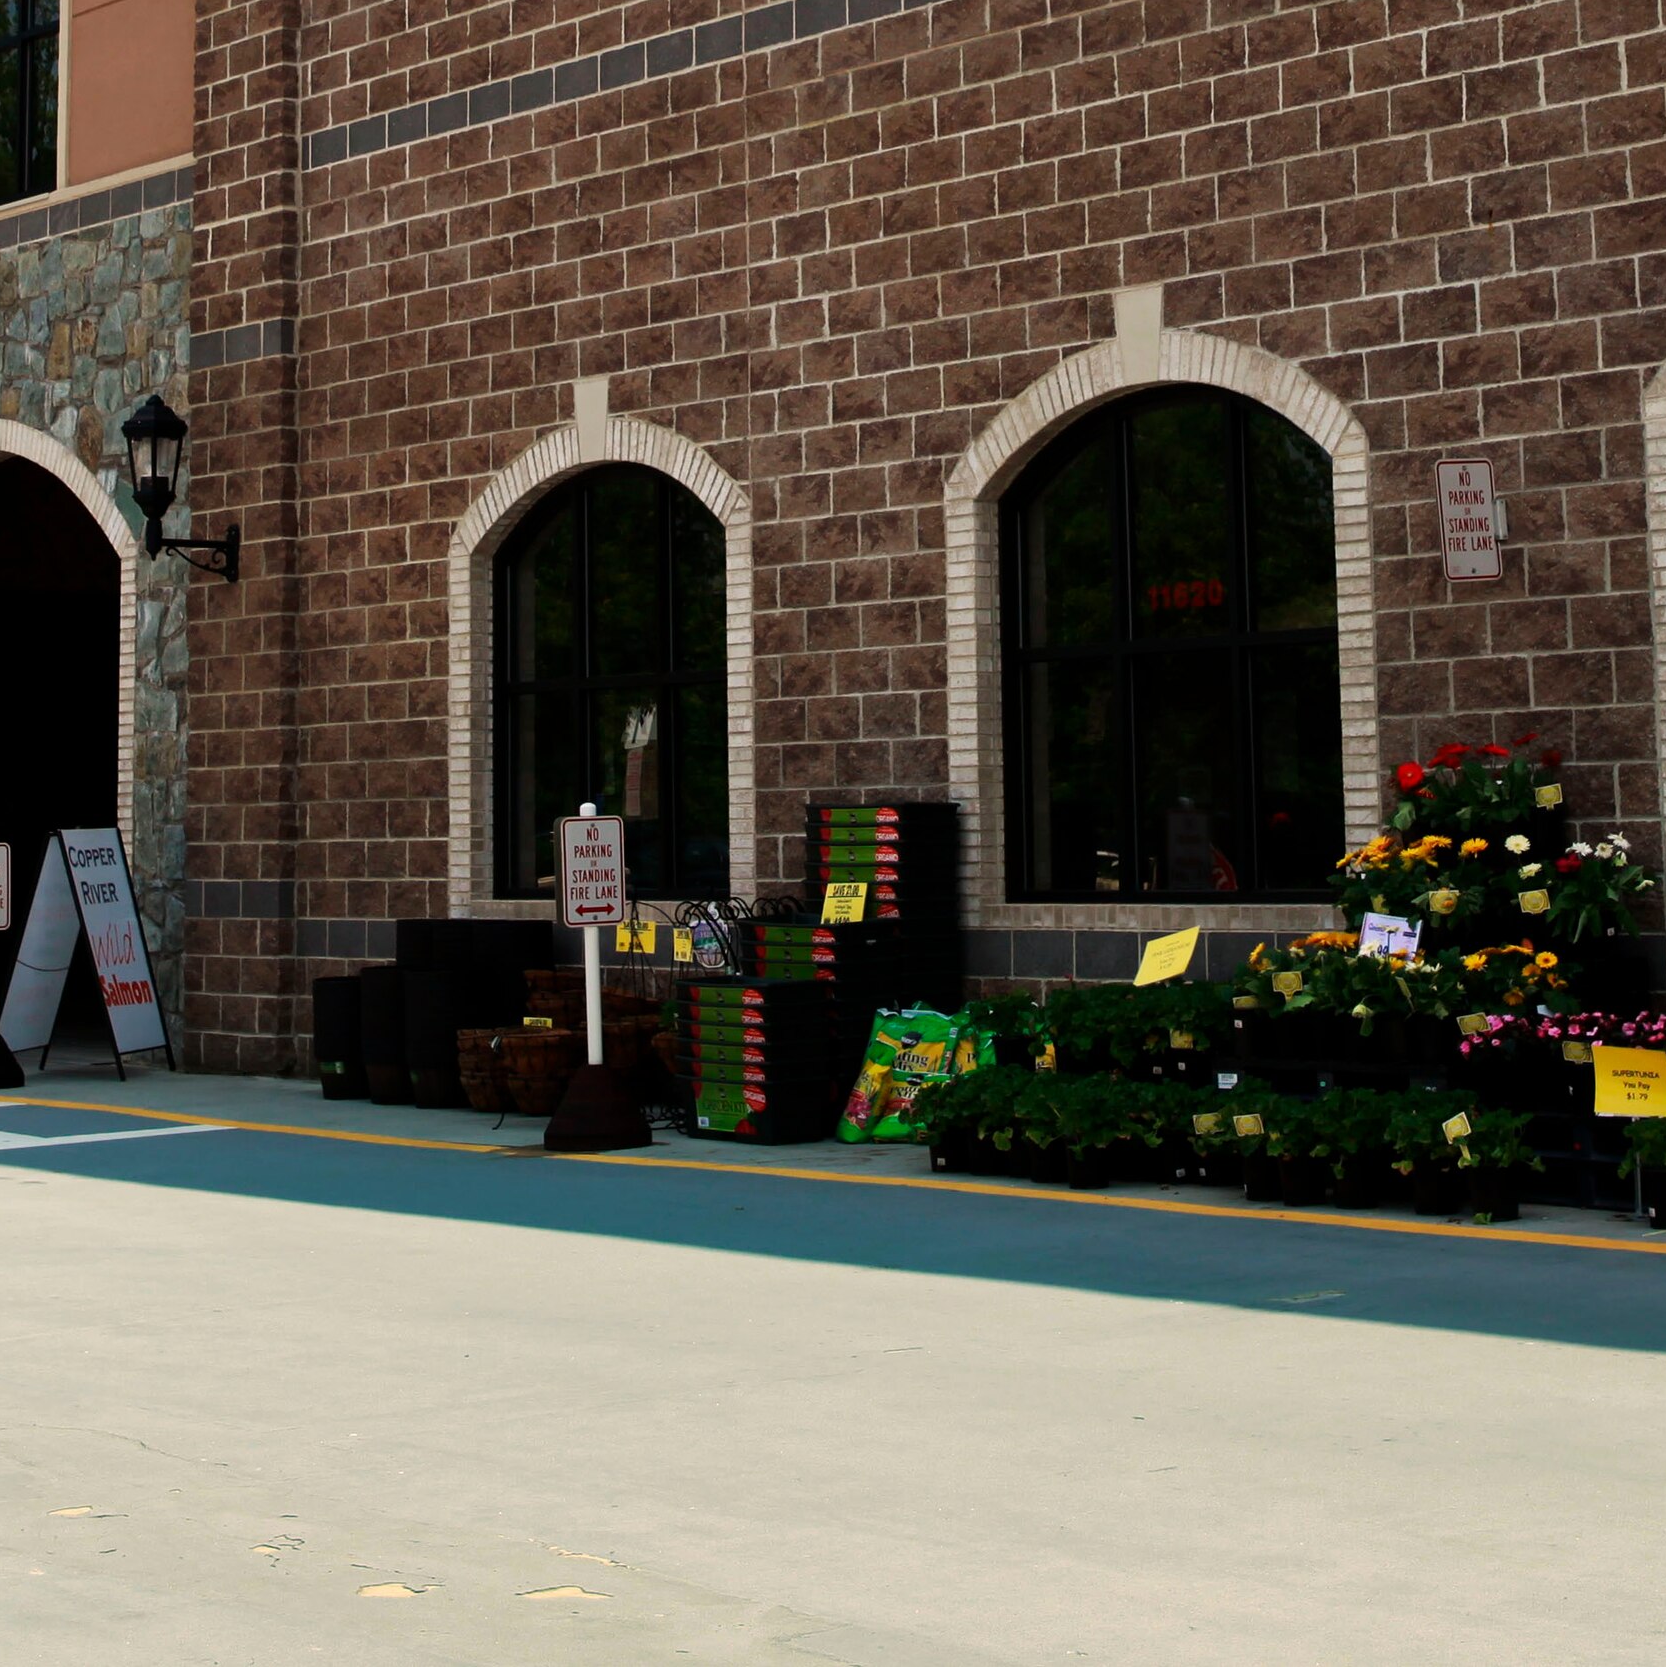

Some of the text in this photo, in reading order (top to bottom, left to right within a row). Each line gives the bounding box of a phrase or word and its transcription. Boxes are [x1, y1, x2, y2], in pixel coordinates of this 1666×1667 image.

[1458, 471, 1471, 487] NO
[1448, 490, 1485, 505] PARKING
[1449, 517, 1490, 533] STANDING
[1448, 535, 1493, 552] FIRE LANE
[1148, 577, 1225, 612] 11620
[586, 827, 599, 841] NO
[68, 846, 116, 868] COPPER
[574, 844, 612, 858] PARKING
[572, 868, 616, 884] STANDING
[80, 881, 118, 905] RIVER
[570, 885, 618, 900] FIRE LANE
[91, 920, 135, 968] Wild
[99, 973, 153, 1007] Salmon
[1612, 1070, 1660, 1078] SUPERTUNIA
[1638, 1081, 1651, 1091] Pay
